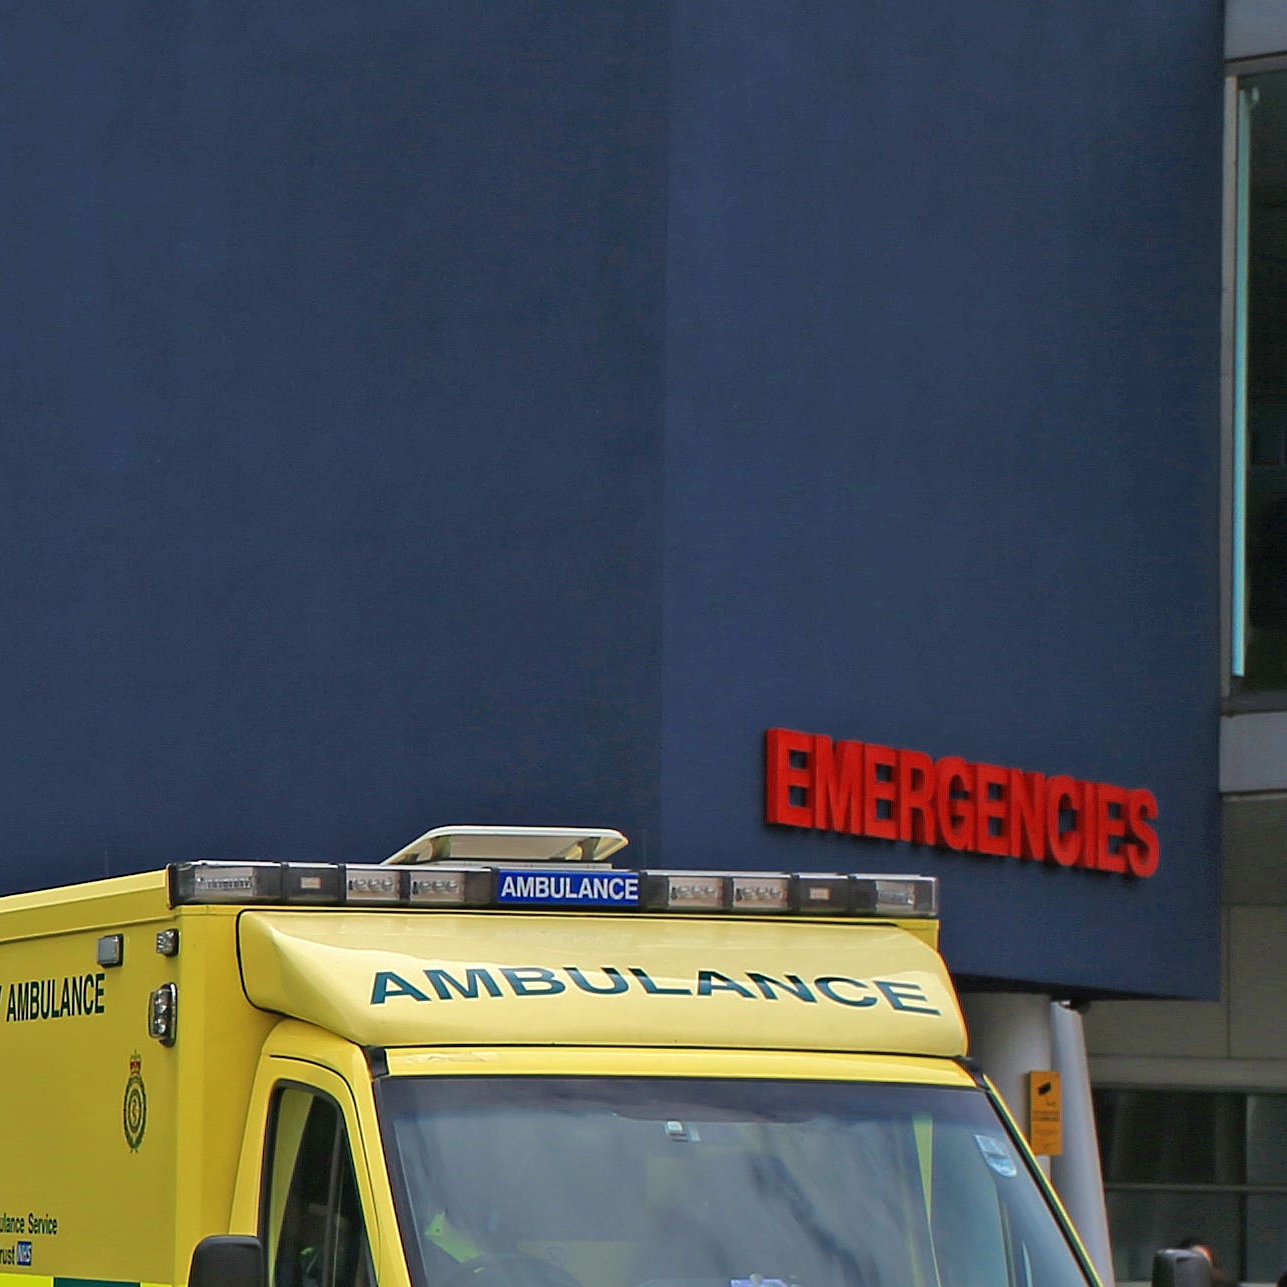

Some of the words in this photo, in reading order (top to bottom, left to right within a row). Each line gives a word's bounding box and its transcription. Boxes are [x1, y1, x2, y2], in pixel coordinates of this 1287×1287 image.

[765, 727, 1160, 878] EMERGENCIES
[500, 875, 638, 900] AMBULANCE
[6, 973, 105, 1022] AMBULANCE
[371, 966, 942, 1017] AMBULANCE
[28, 1212, 57, 1234] Service
